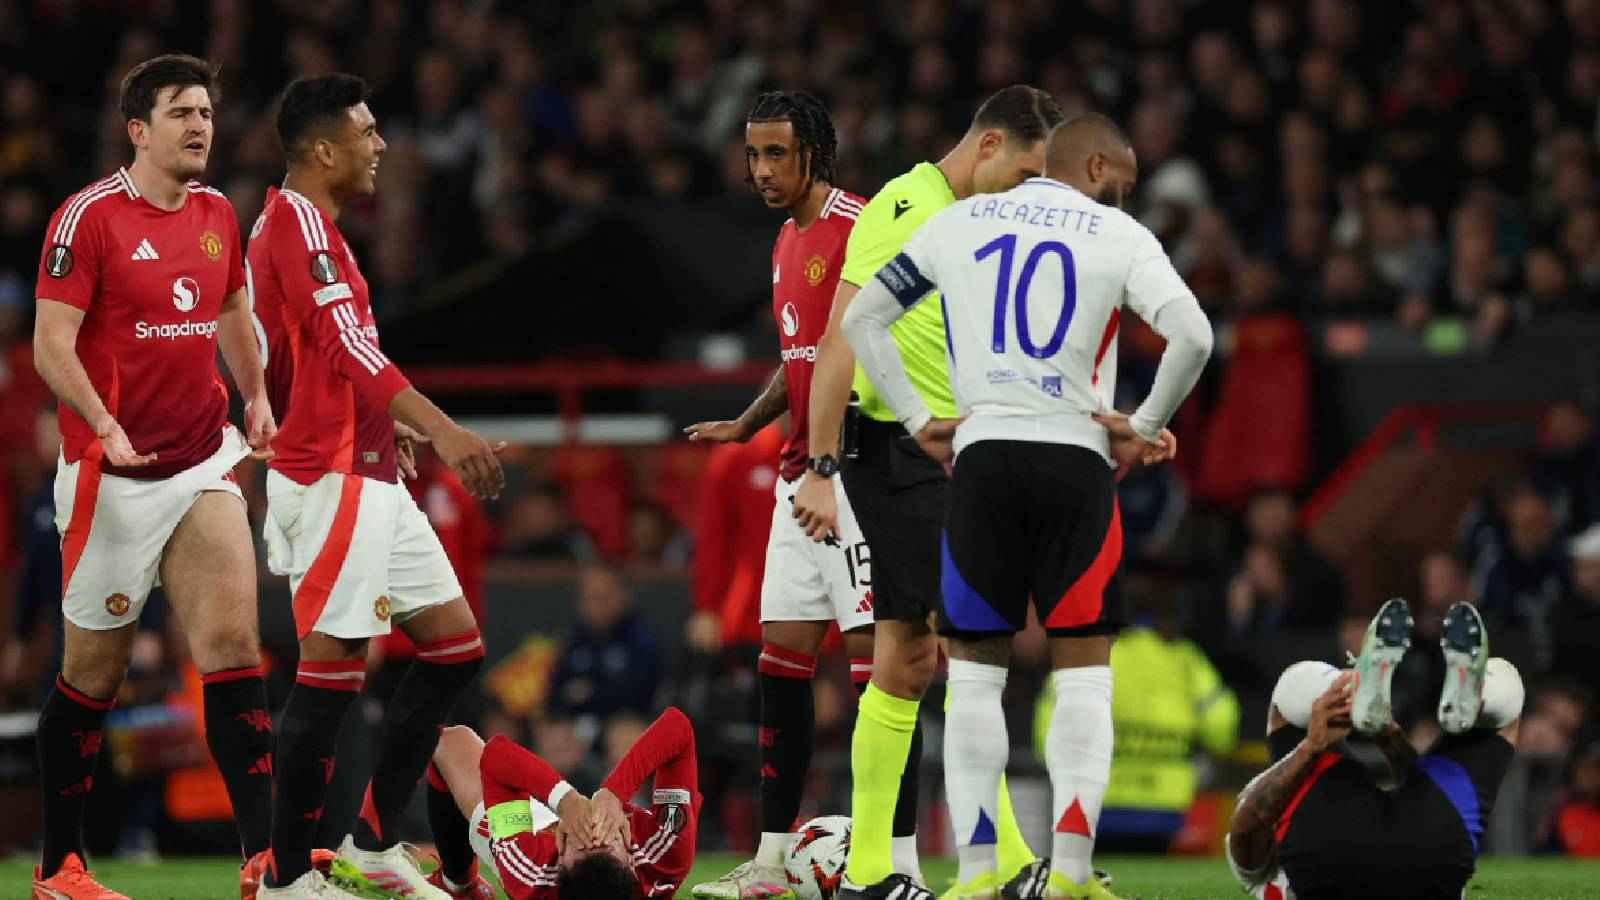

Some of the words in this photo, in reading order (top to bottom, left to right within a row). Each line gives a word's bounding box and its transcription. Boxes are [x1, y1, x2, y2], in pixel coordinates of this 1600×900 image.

[971, 199, 1103, 235] LACAZETTE
[974, 233, 1077, 360] 10
[844, 541, 871, 590] 15
